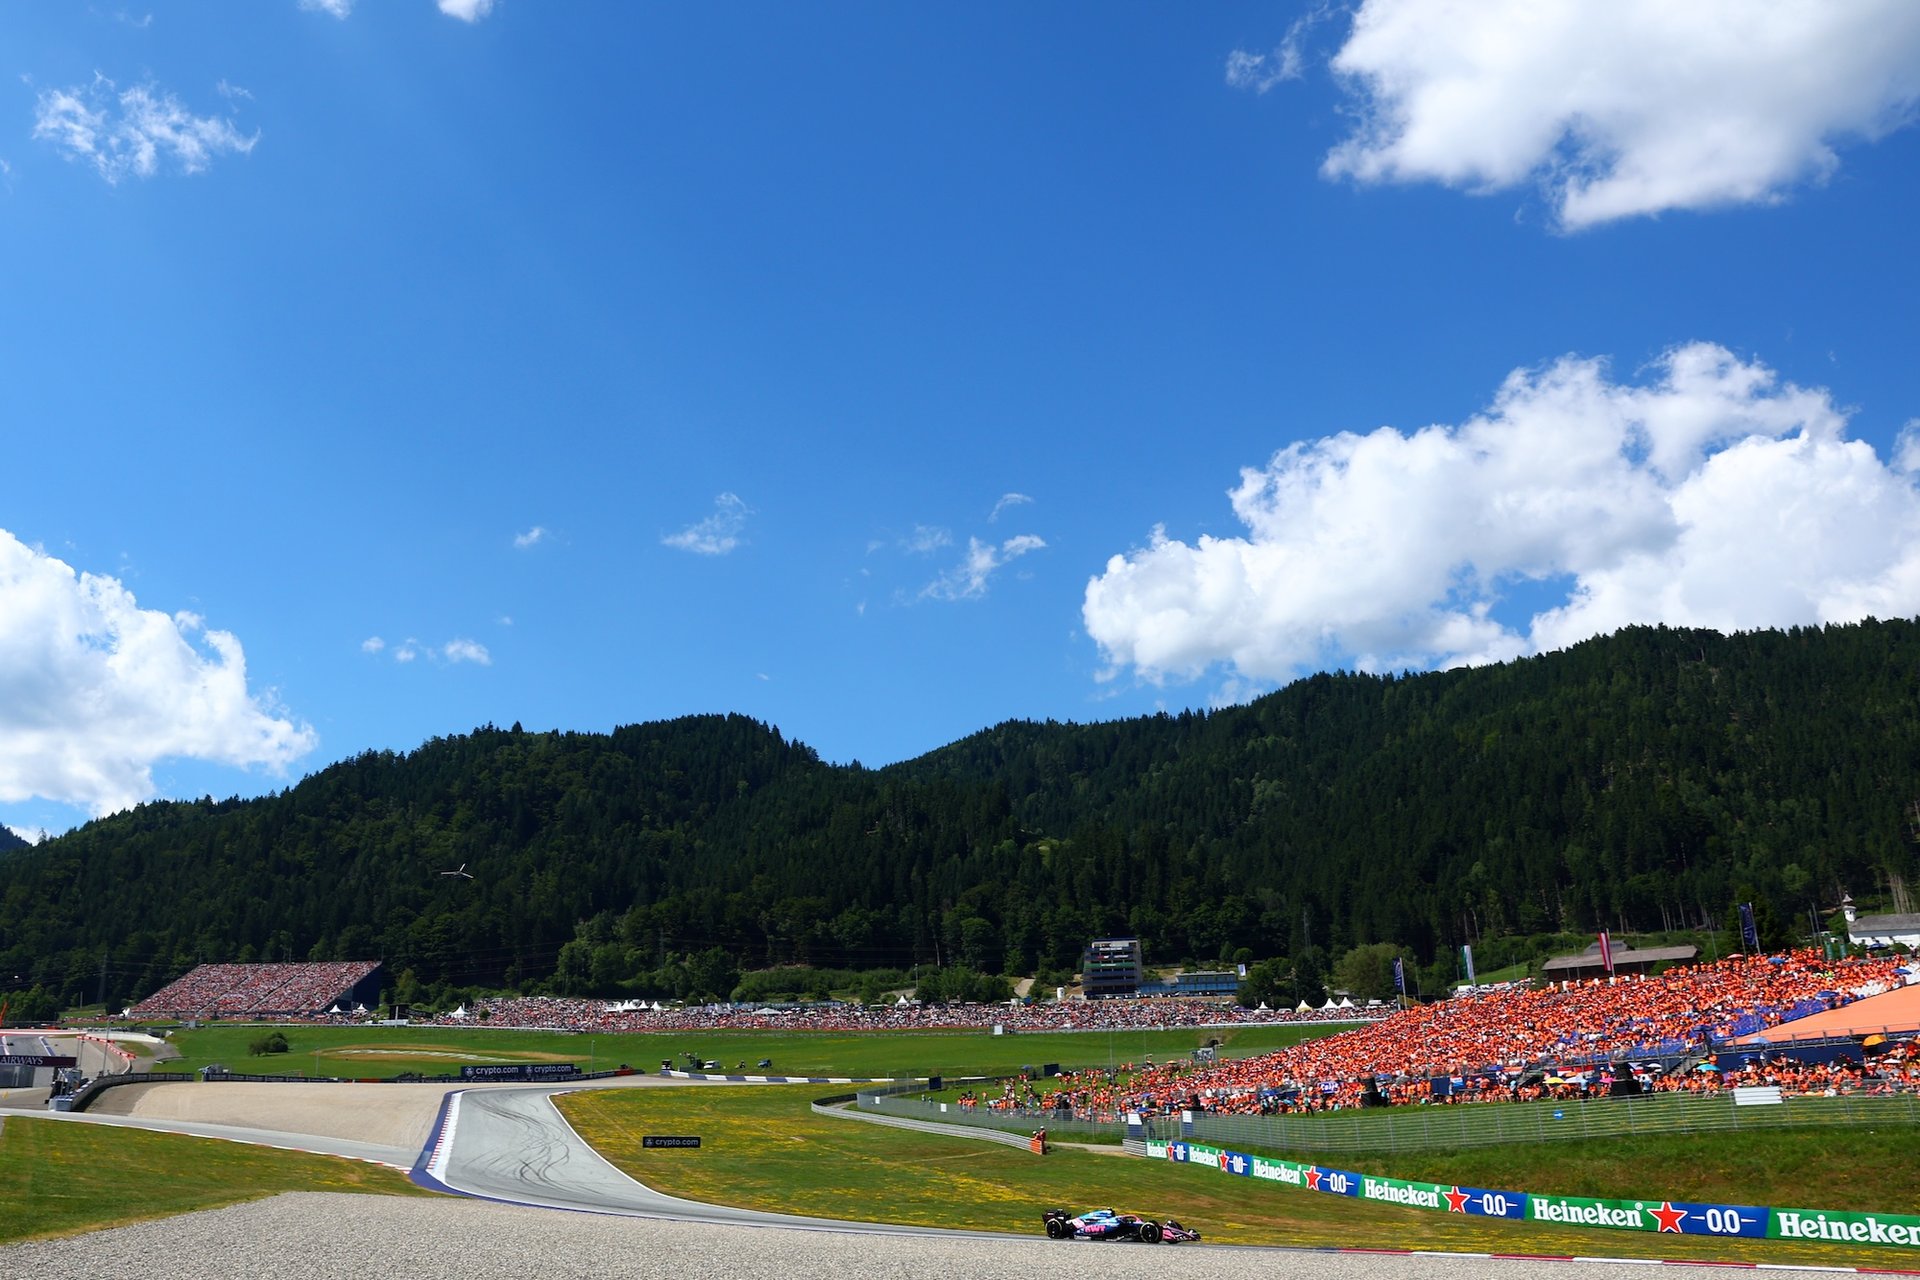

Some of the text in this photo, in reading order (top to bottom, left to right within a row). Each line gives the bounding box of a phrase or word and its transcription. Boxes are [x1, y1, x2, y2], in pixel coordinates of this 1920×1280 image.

[0, 1056, 43, 1065] AIRWAYS
[475, 1066, 519, 1075] crypto.com
[534, 1065, 571, 1074] crypto.com
